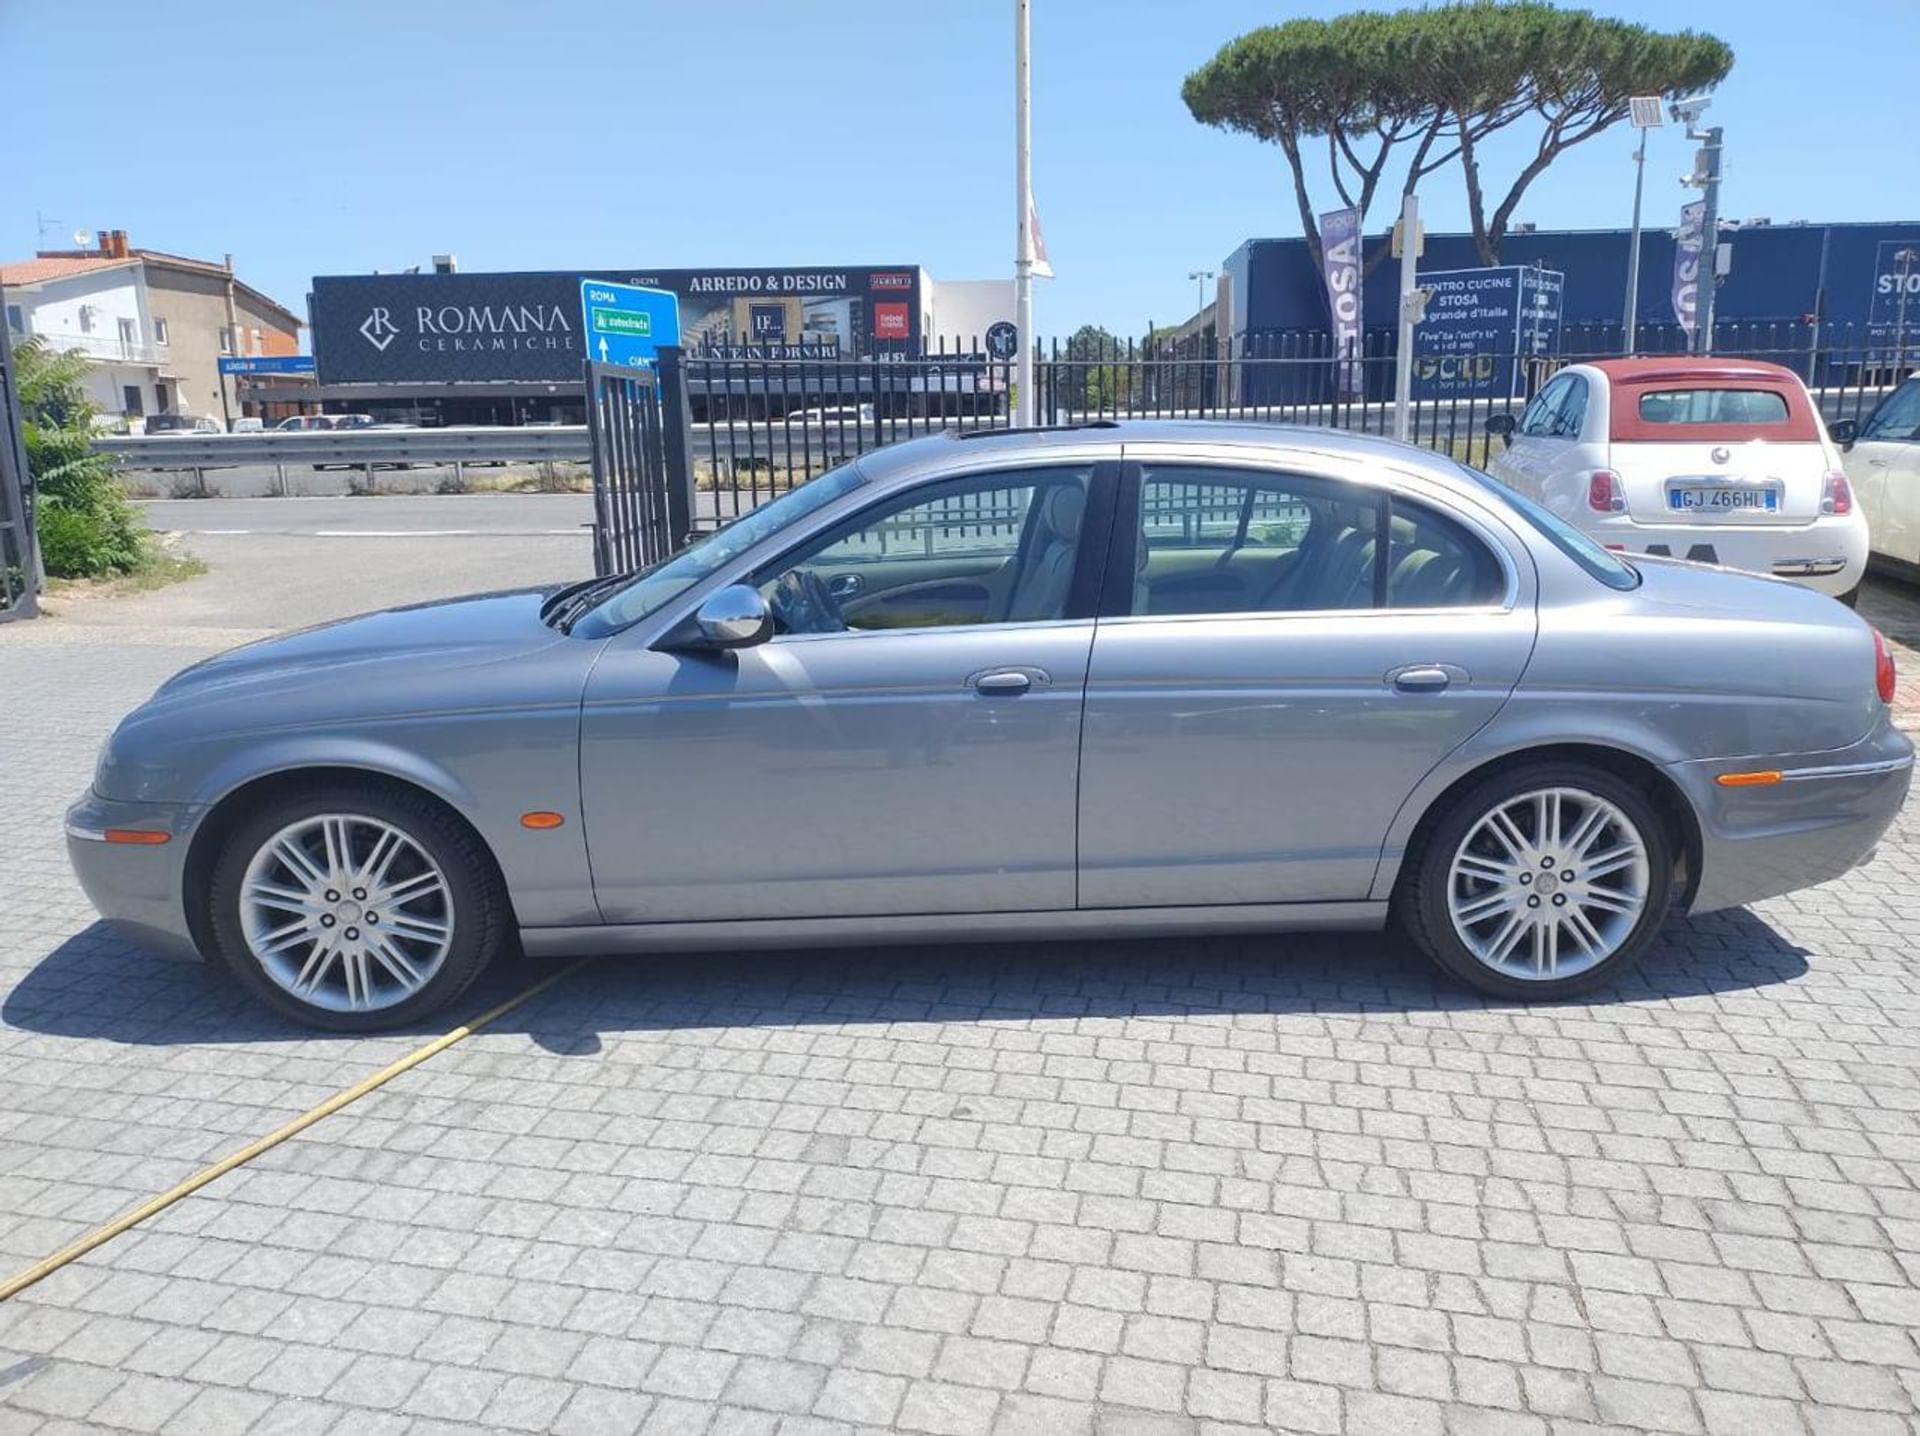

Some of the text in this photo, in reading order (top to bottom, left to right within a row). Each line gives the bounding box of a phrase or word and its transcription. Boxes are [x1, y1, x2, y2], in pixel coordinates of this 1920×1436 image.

[690, 274, 847, 292] ARREDO & DESIGN
[1467, 277, 1512, 290] CUCINE
[590, 289, 616, 303] ROMA
[1439, 294, 1479, 306] STOSA
[417, 305, 571, 334] ROMANA
[1429, 309, 1467, 322] grande
[420, 335, 574, 352] CERAMICHE
[1683, 491, 1704, 507] GJ
[1711, 491, 1763, 508] 466HL
